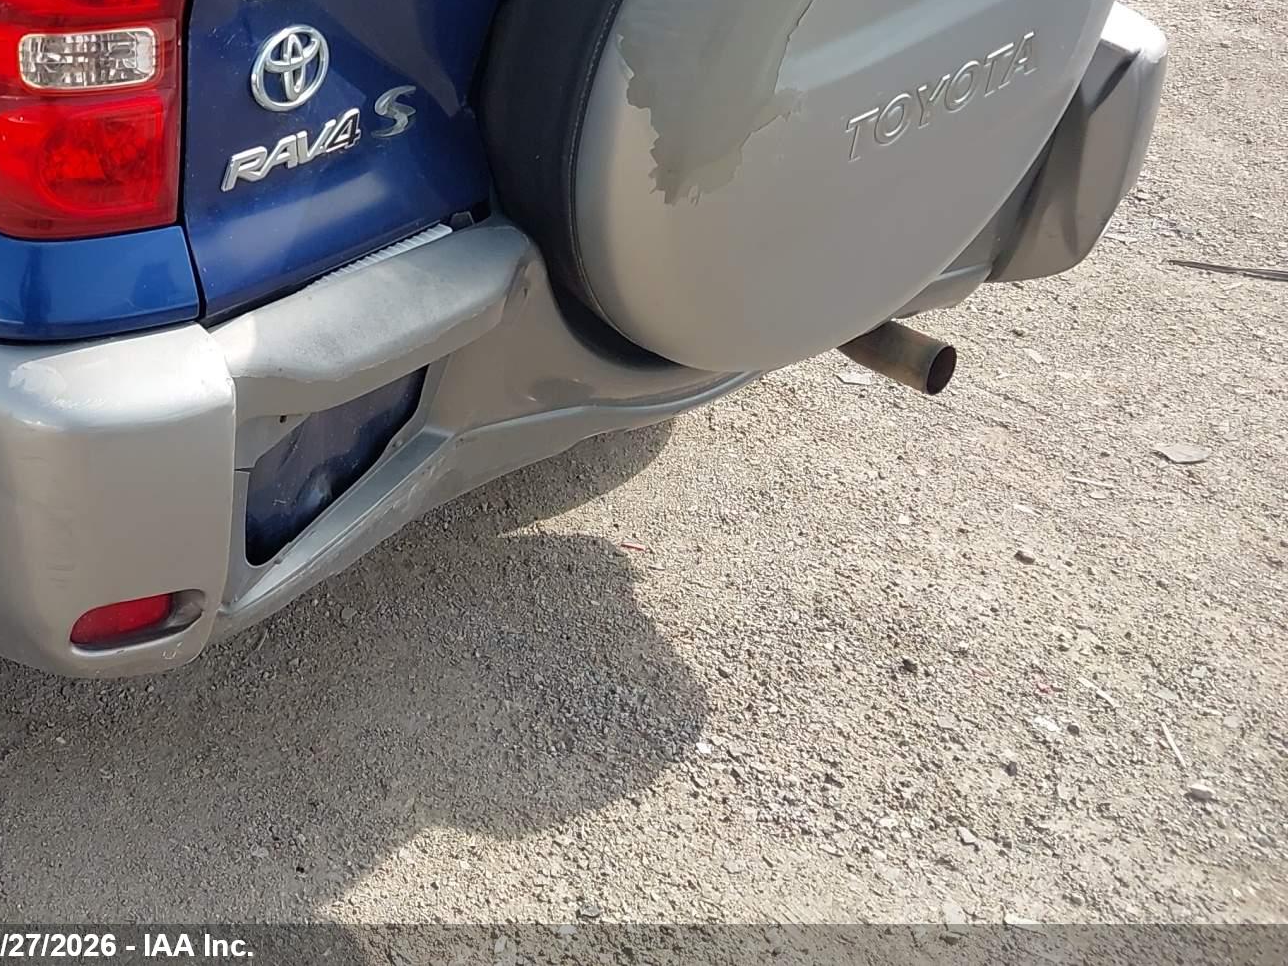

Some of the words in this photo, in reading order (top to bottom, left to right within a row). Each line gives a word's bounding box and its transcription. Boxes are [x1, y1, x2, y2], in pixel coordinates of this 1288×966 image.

[221, 107, 362, 192] RAV4
[371, 85, 417, 138] S
[845, 30, 1037, 163] TOYOTA
